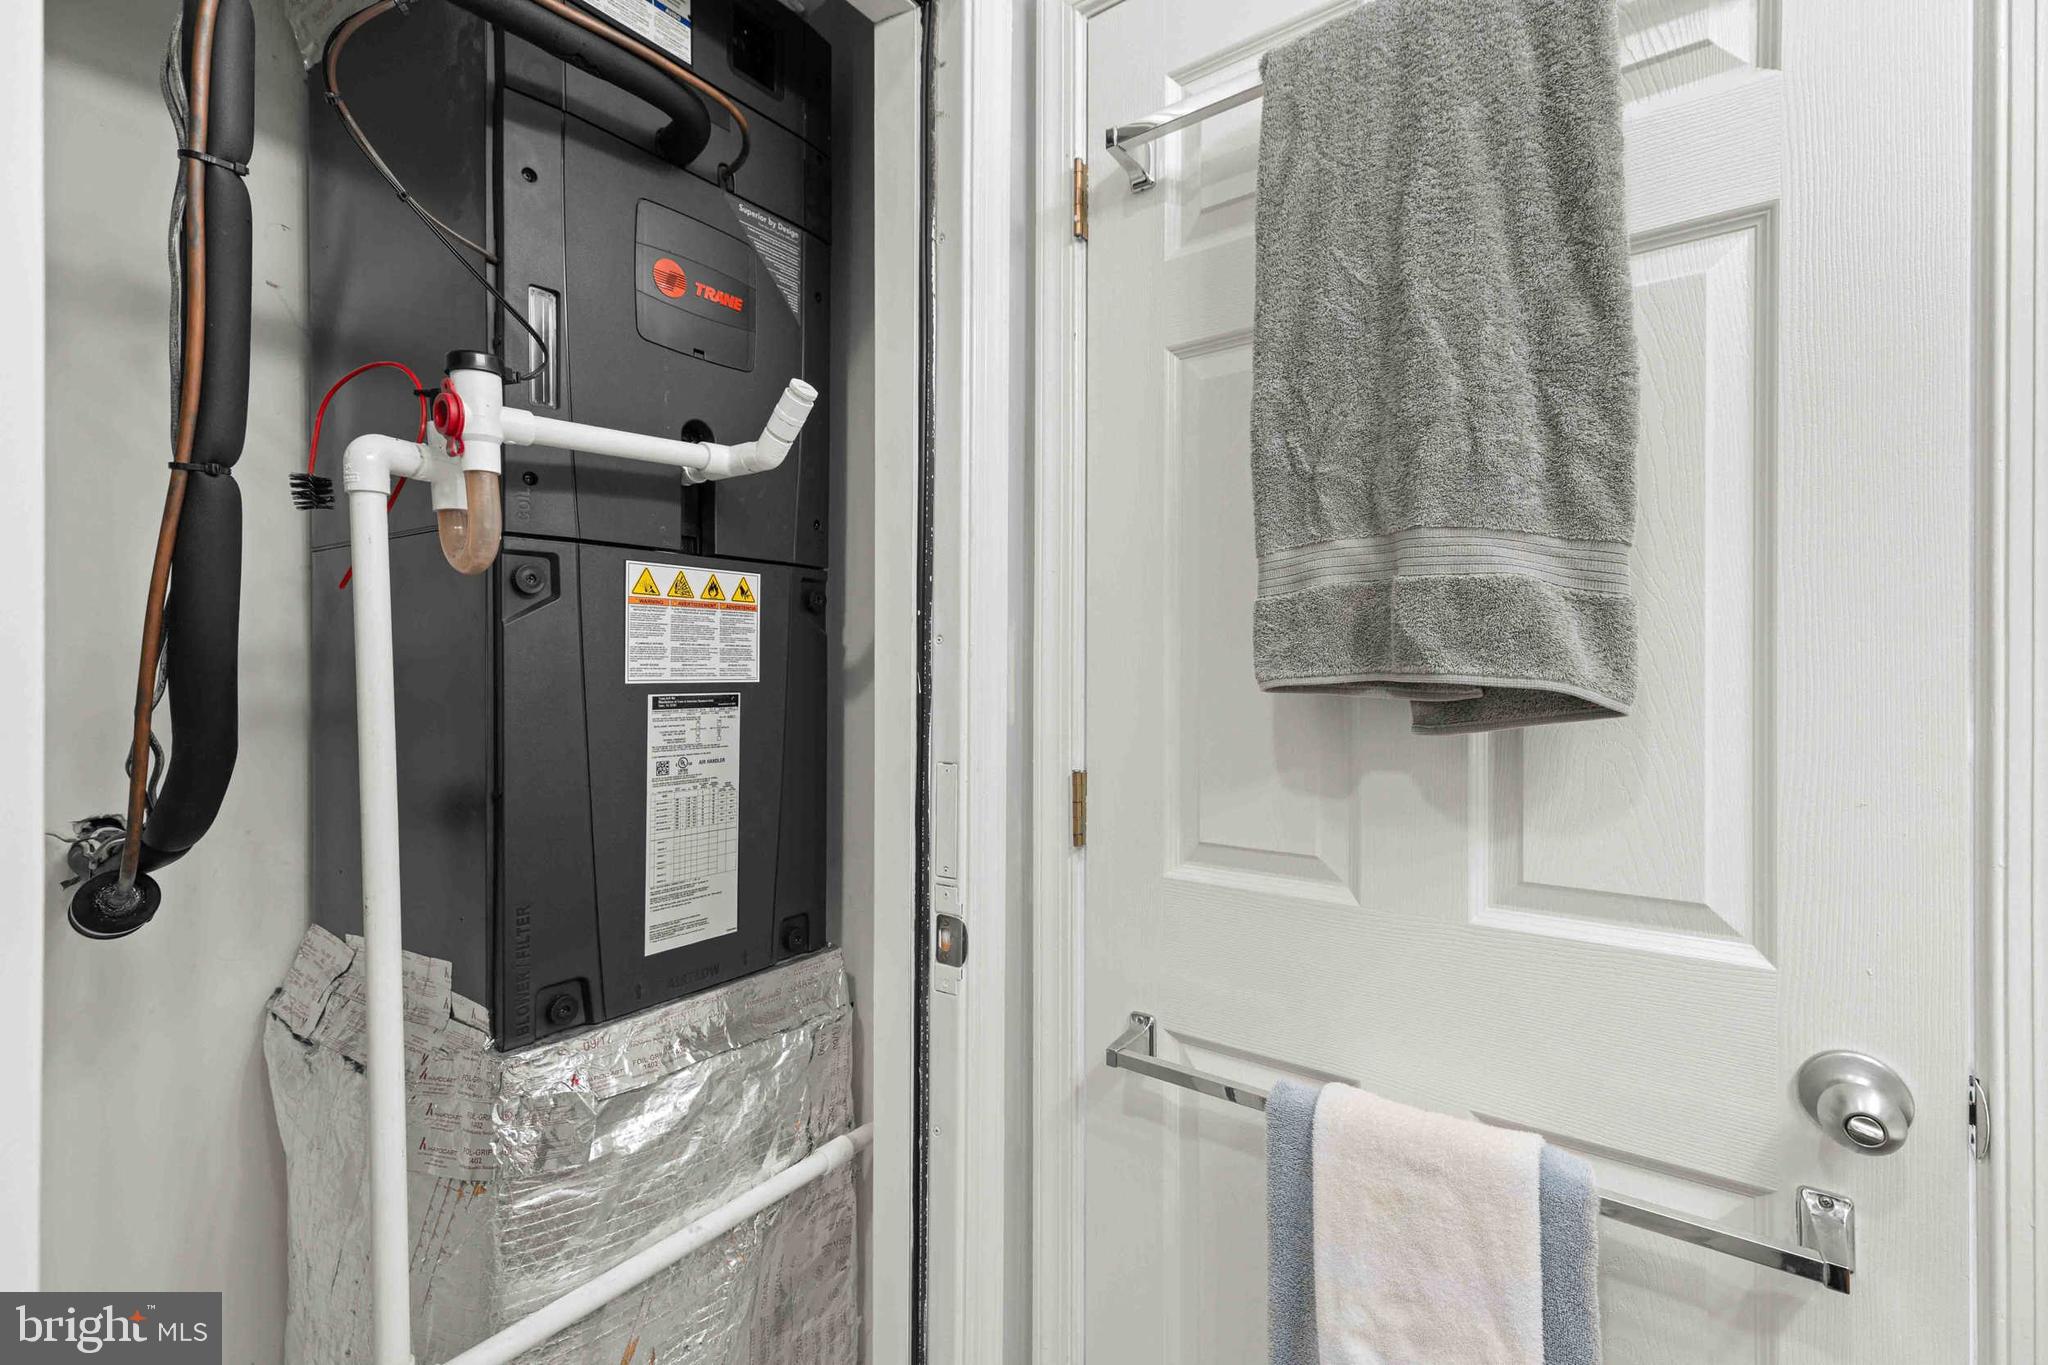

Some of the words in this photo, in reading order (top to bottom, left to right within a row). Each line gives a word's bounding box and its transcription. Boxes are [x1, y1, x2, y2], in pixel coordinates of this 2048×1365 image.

[738, 203, 767, 223] Superior
[768, 217, 777, 229] by
[777, 222, 799, 239] Design
[695, 281, 744, 313] TRANE
